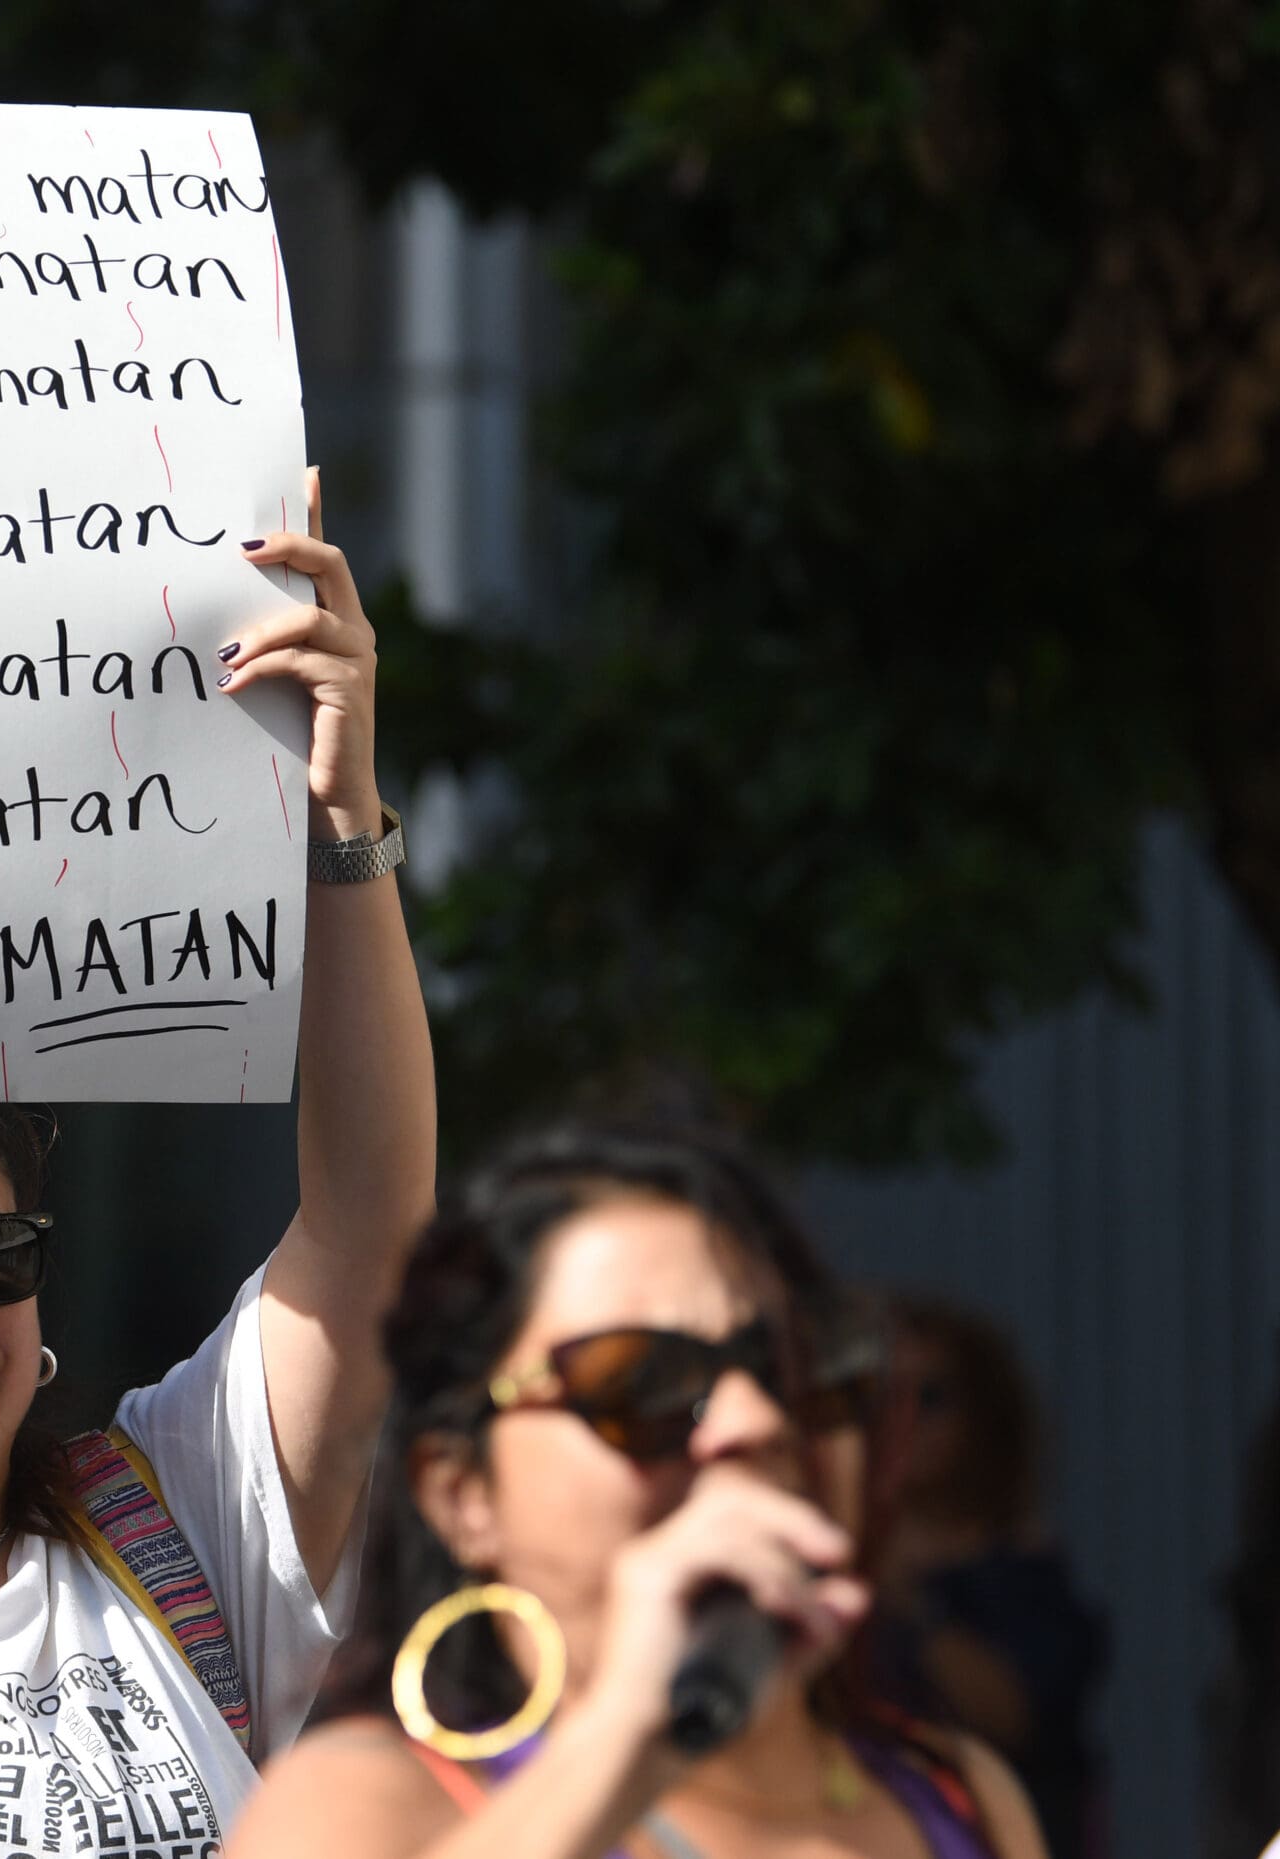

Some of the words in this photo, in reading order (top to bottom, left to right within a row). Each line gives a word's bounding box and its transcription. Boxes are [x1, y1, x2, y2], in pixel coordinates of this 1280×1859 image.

[27, 149, 270, 224] matan
[0, 898, 277, 1004] MATAN
[92, 1788, 205, 1849] ELLE
[188, 1777, 219, 1838] NOSOTROS
